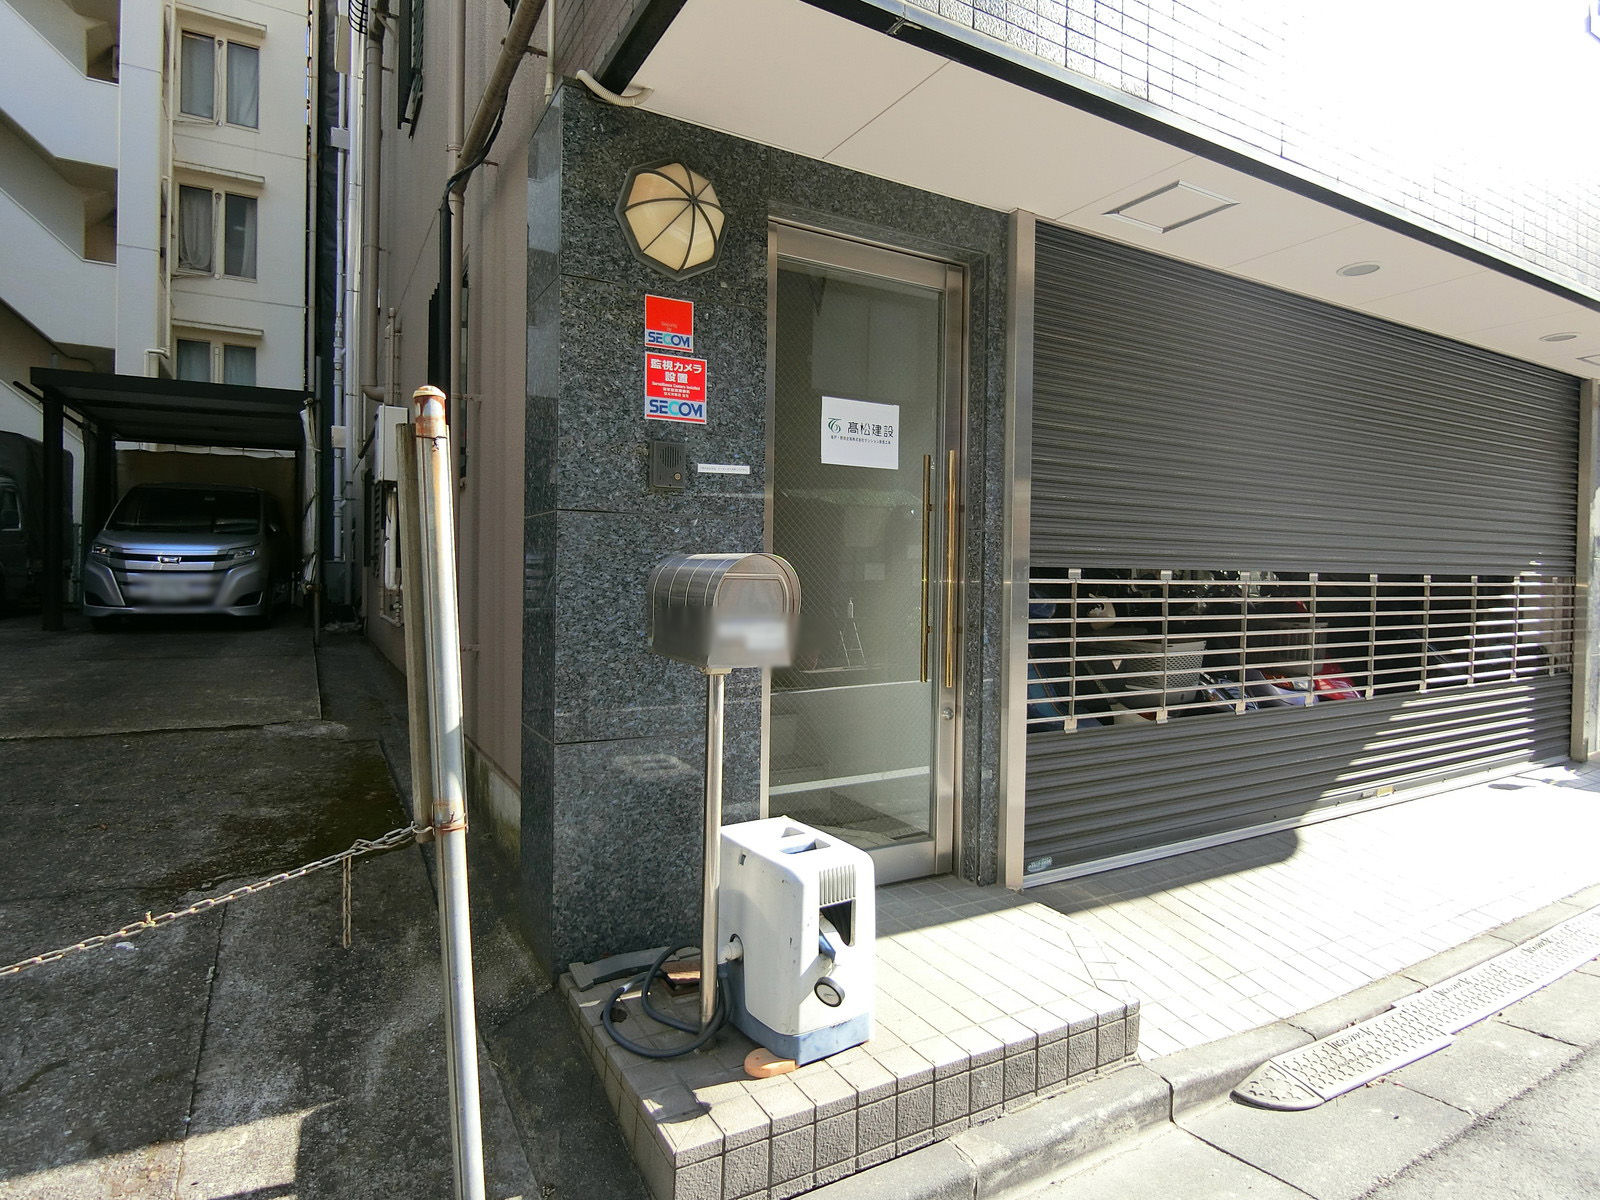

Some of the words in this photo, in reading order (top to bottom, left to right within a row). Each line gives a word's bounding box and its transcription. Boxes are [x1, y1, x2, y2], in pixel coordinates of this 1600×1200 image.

[648, 331, 690, 348] SECOM
[650, 358, 702, 374] 監視カメラ
[665, 371, 688, 383] 設置
[649, 399, 702, 417] SECOM
